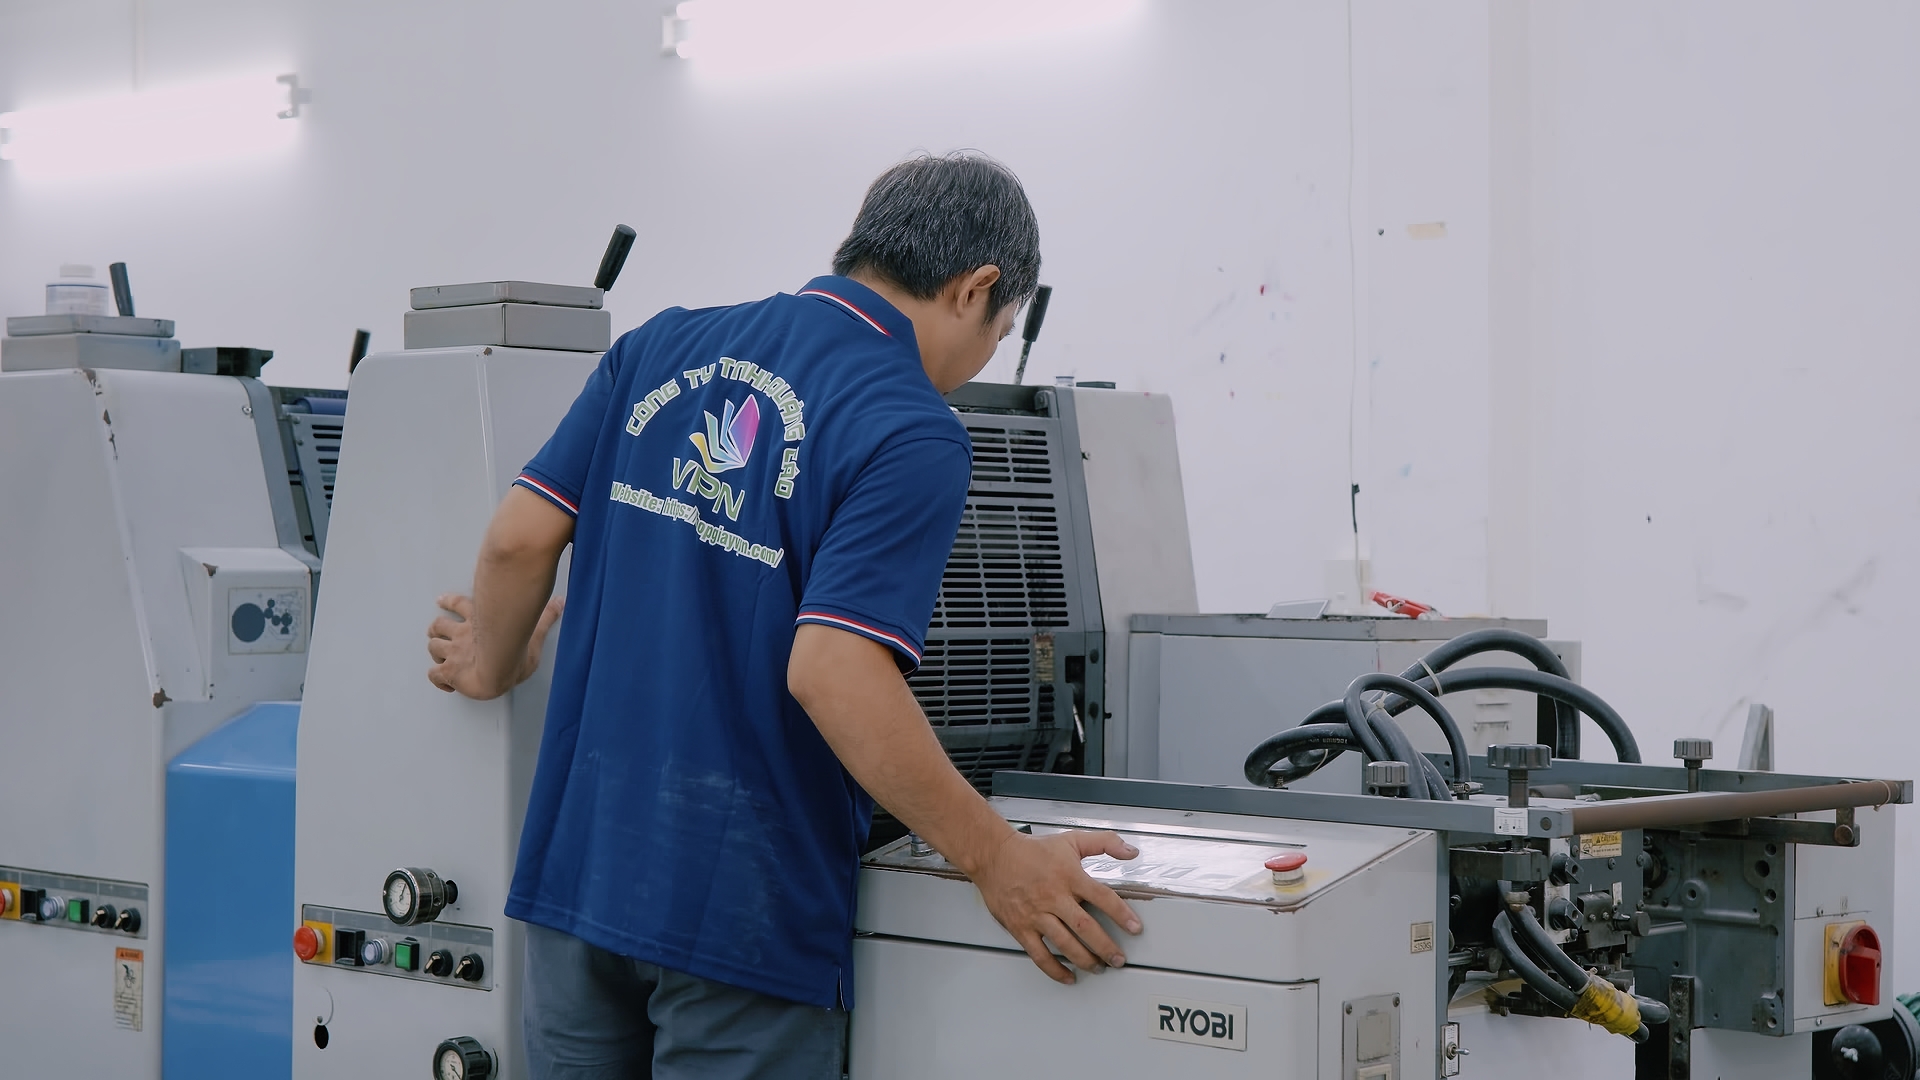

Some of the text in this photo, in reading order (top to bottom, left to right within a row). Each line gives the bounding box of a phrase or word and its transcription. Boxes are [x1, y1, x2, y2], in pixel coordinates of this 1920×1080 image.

[626, 378, 681, 436] CÔNG
[683, 363, 716, 389] TY
[673, 458, 745, 521] VPN
[1158, 1004, 1234, 1040] RYOBI
